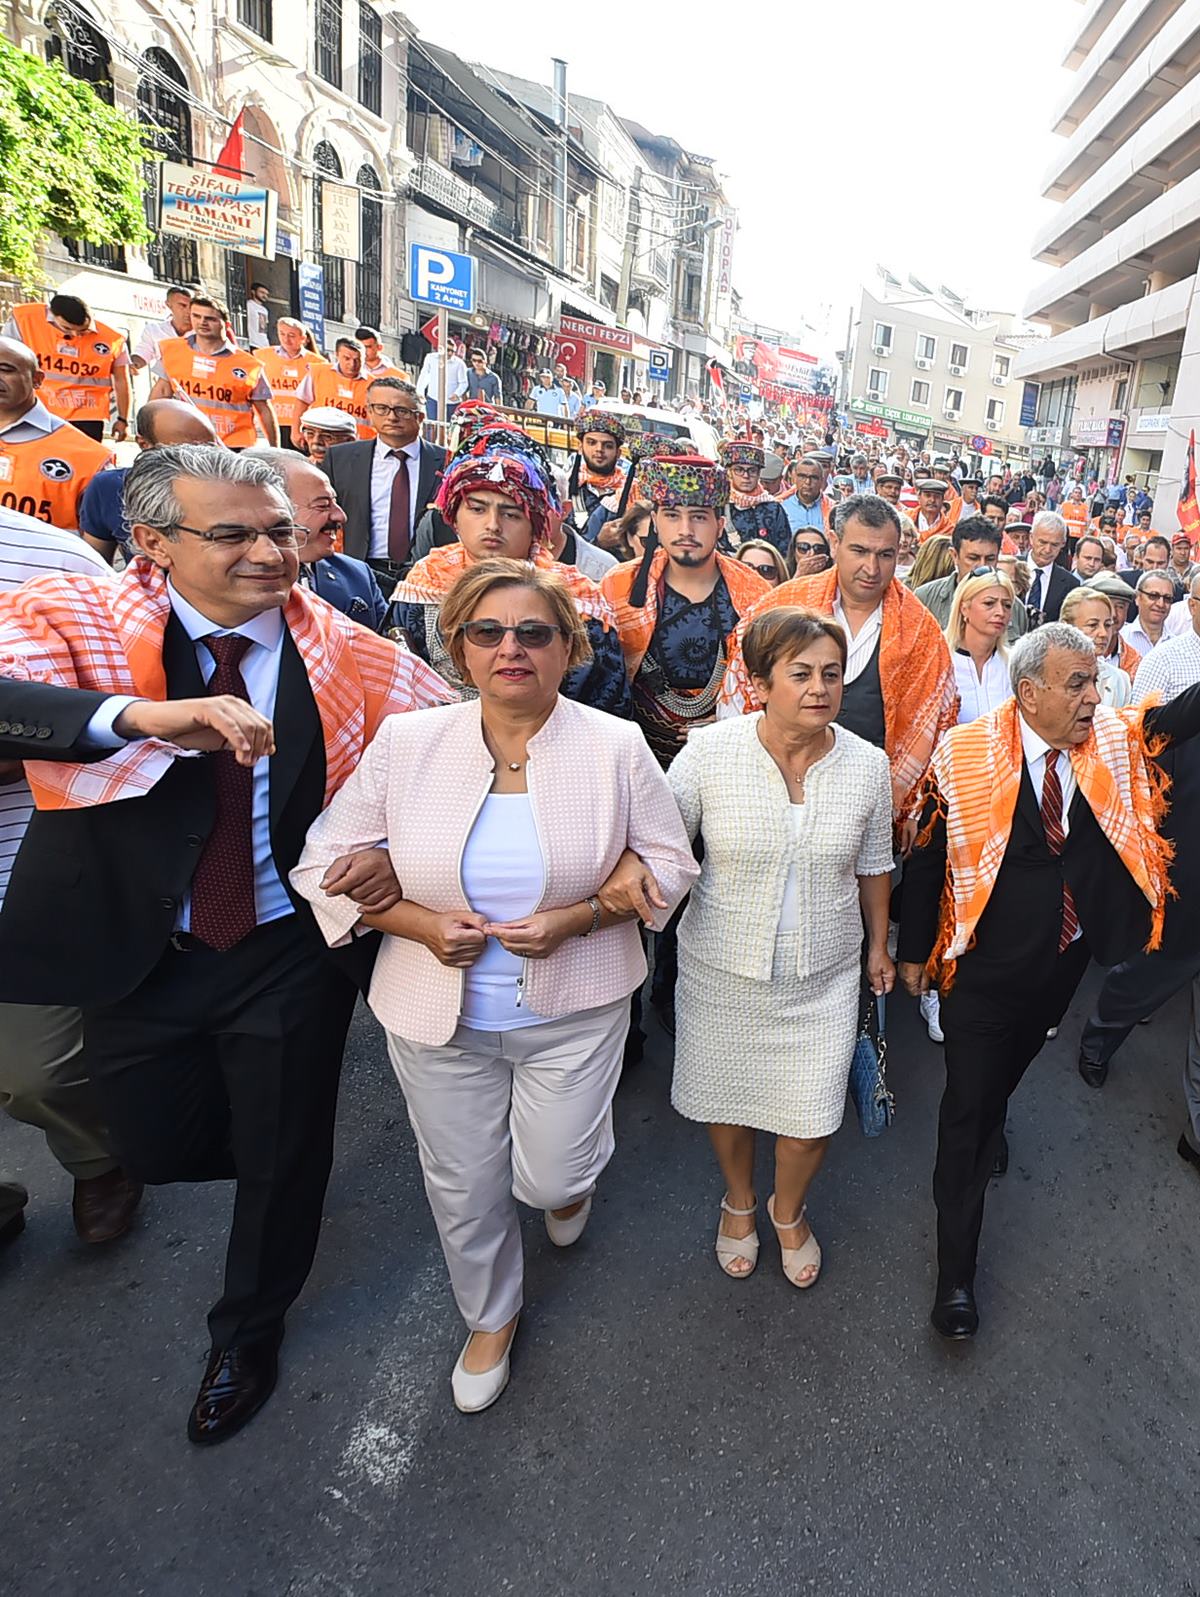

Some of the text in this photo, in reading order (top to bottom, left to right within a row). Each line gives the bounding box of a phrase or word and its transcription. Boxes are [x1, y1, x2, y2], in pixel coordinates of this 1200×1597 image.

[418, 248, 455, 298] P
[434, 292, 465, 307] 2 Araç
